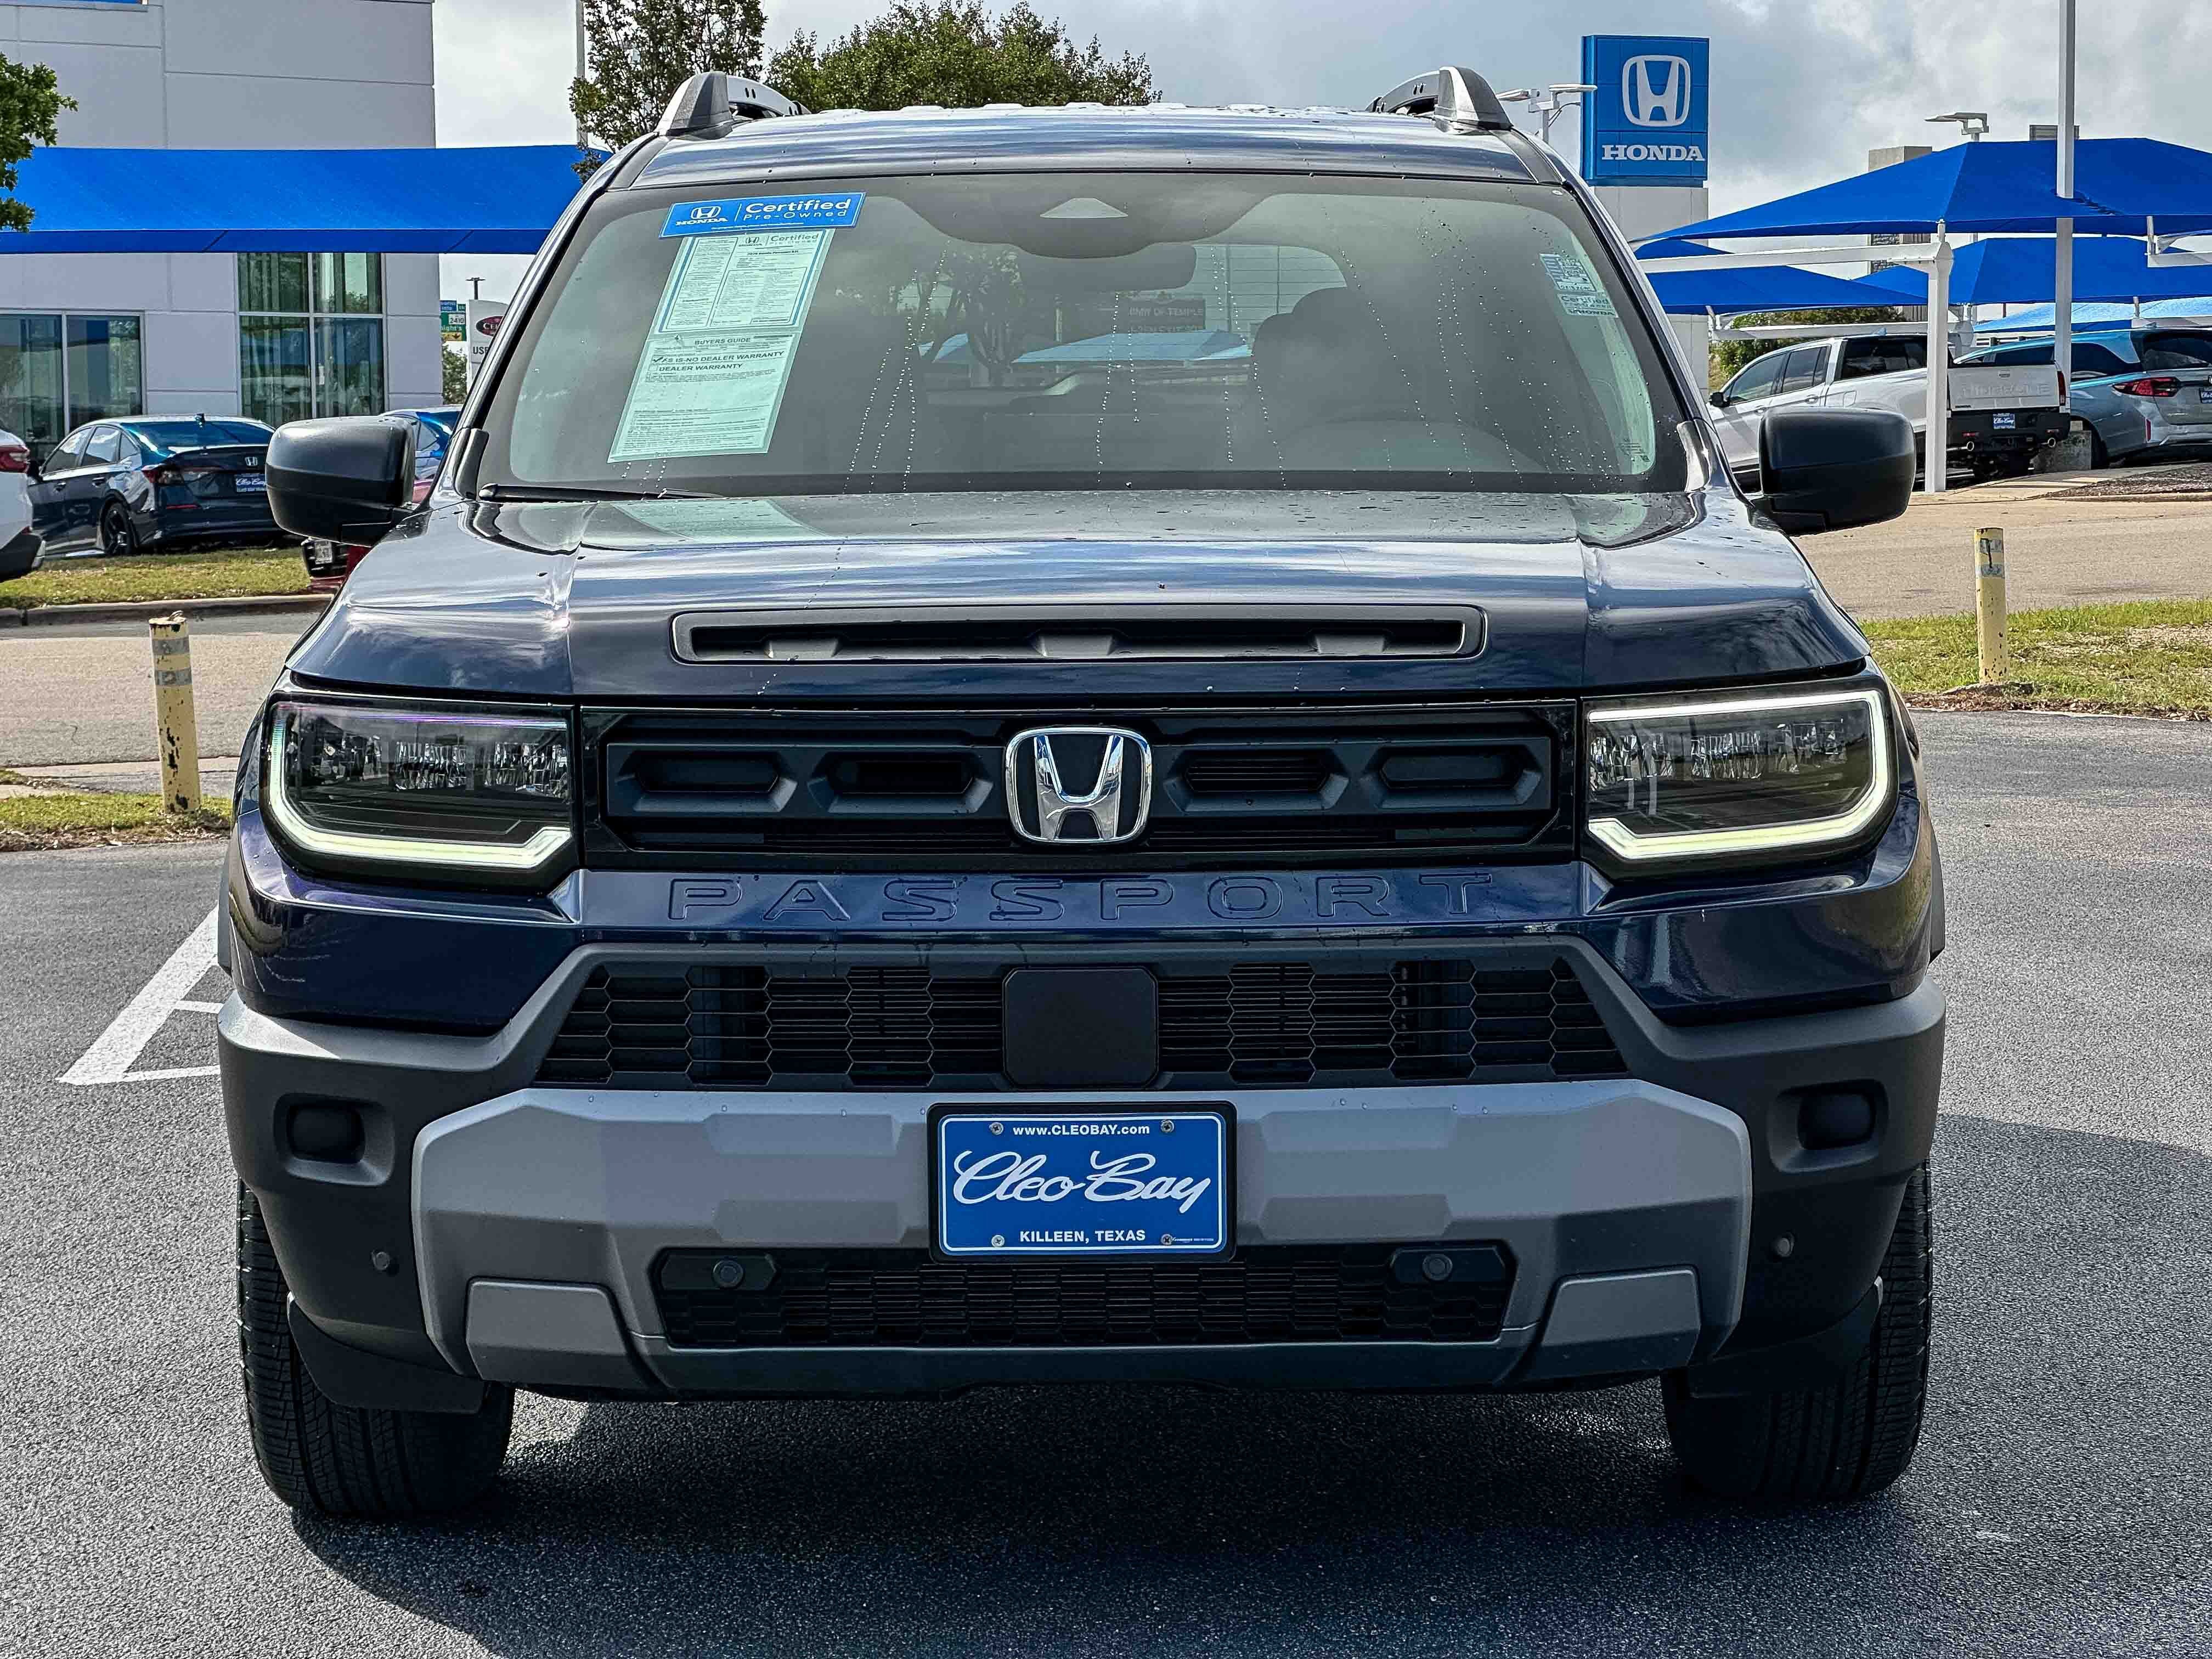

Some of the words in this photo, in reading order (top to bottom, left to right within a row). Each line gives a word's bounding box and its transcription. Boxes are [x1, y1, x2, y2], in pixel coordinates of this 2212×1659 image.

[1601, 144, 1705, 161] HONDA
[746, 199, 851, 213] Certified
[675, 218, 729, 226] HONDA
[743, 210, 847, 221] Pre-Owned
[737, 351, 785, 359] WARRANTY
[668, 873, 1493, 922] PASSPORT
[1013, 1124, 1150, 1136] www.CLEOBAY.com
[953, 1150, 1086, 1204] Cleo
[1084, 1150, 1211, 1214] Bay
[1019, 1231, 1090, 1245] KILLEEN,
[1094, 1229, 1146, 1242] TEXAS
